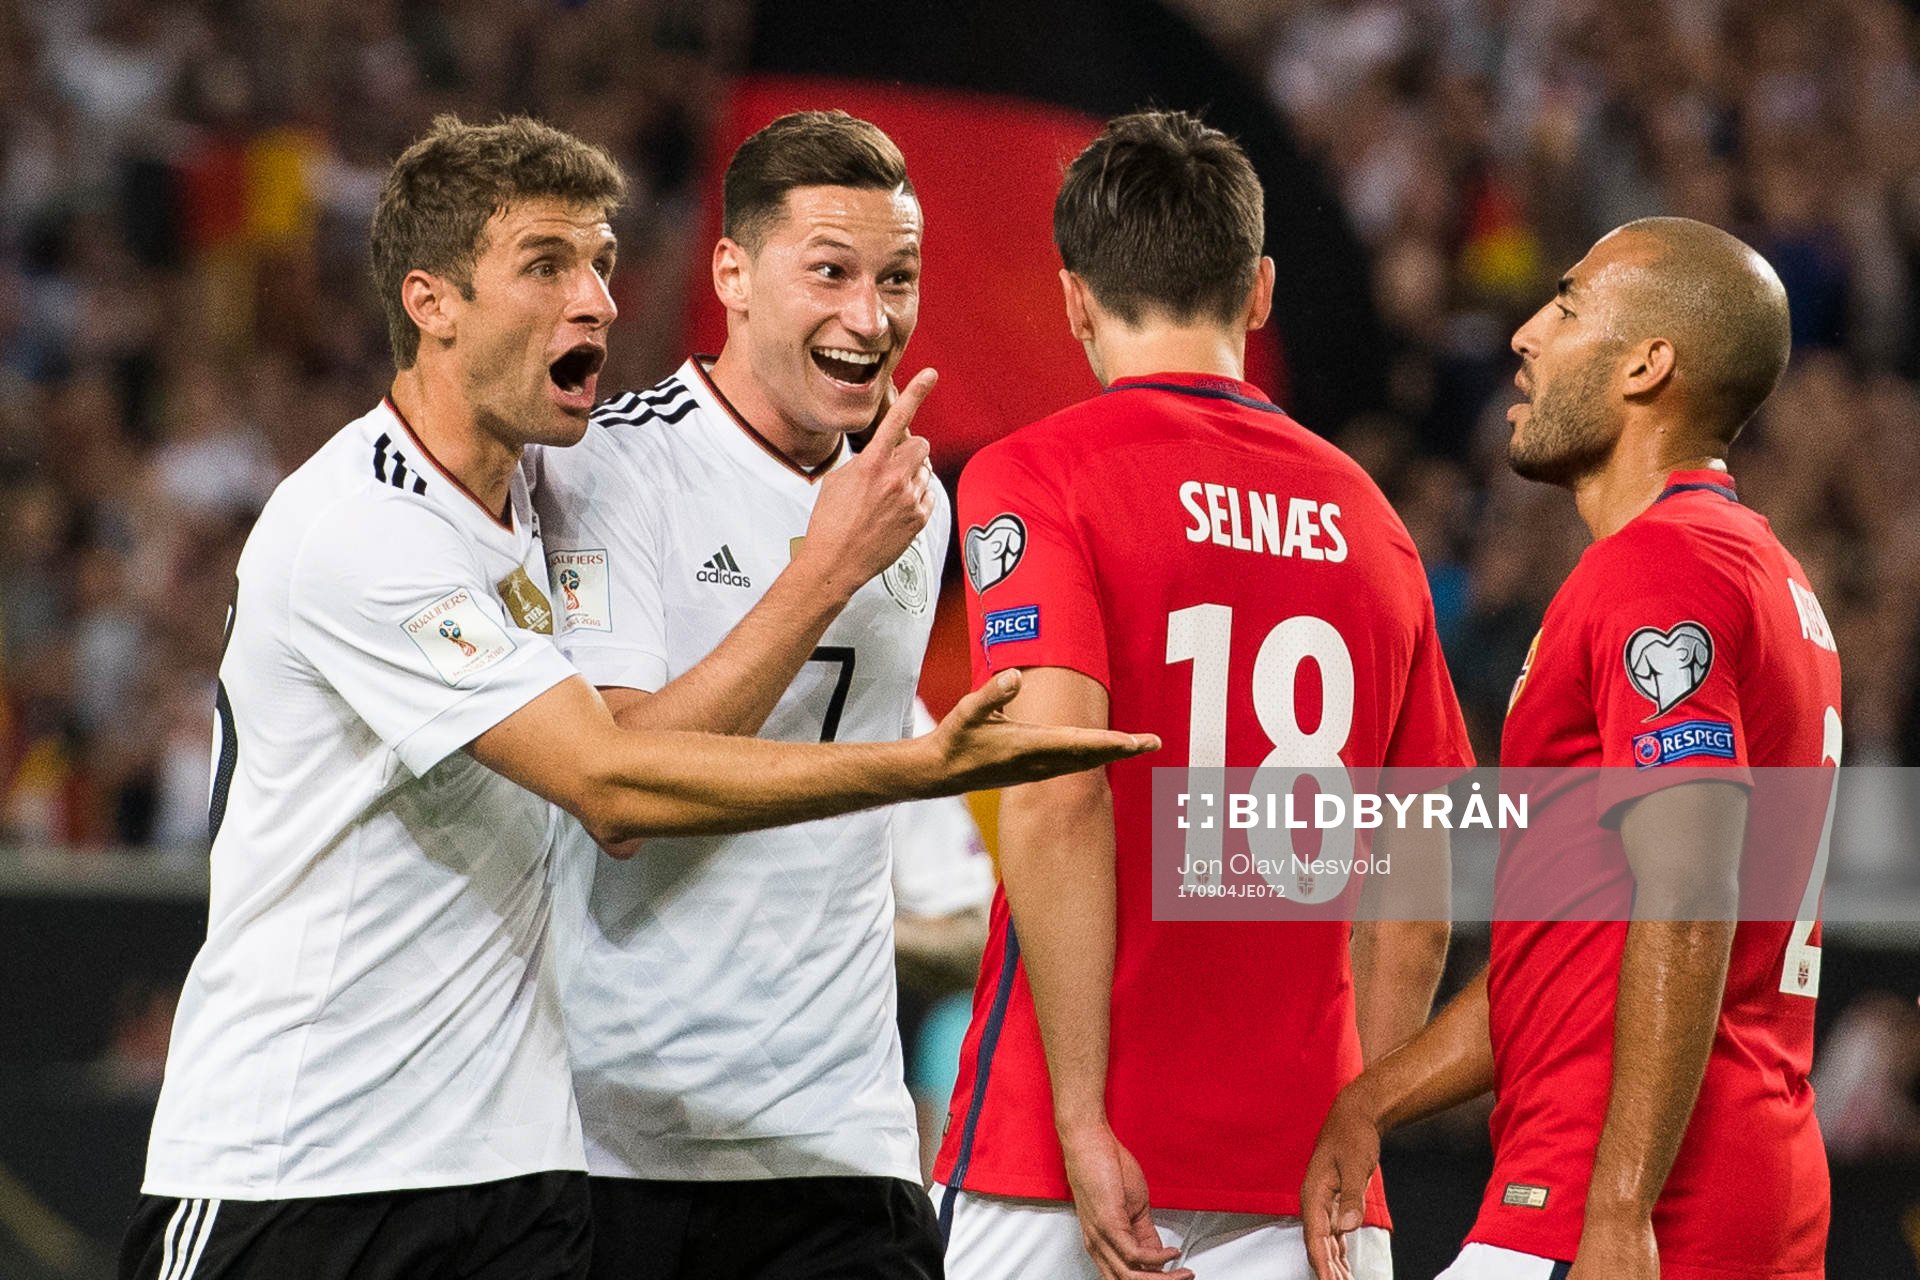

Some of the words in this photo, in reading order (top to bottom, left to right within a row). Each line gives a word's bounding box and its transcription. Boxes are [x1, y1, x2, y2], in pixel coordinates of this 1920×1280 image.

[1179, 480, 1349, 564] SELNÆS
[696, 568, 751, 588] adidas
[407, 591, 468, 634] QUALIFIERS
[808, 646, 856, 743] 7
[1165, 602, 1355, 905] 18
[1662, 729, 1733, 754] RESPECT
